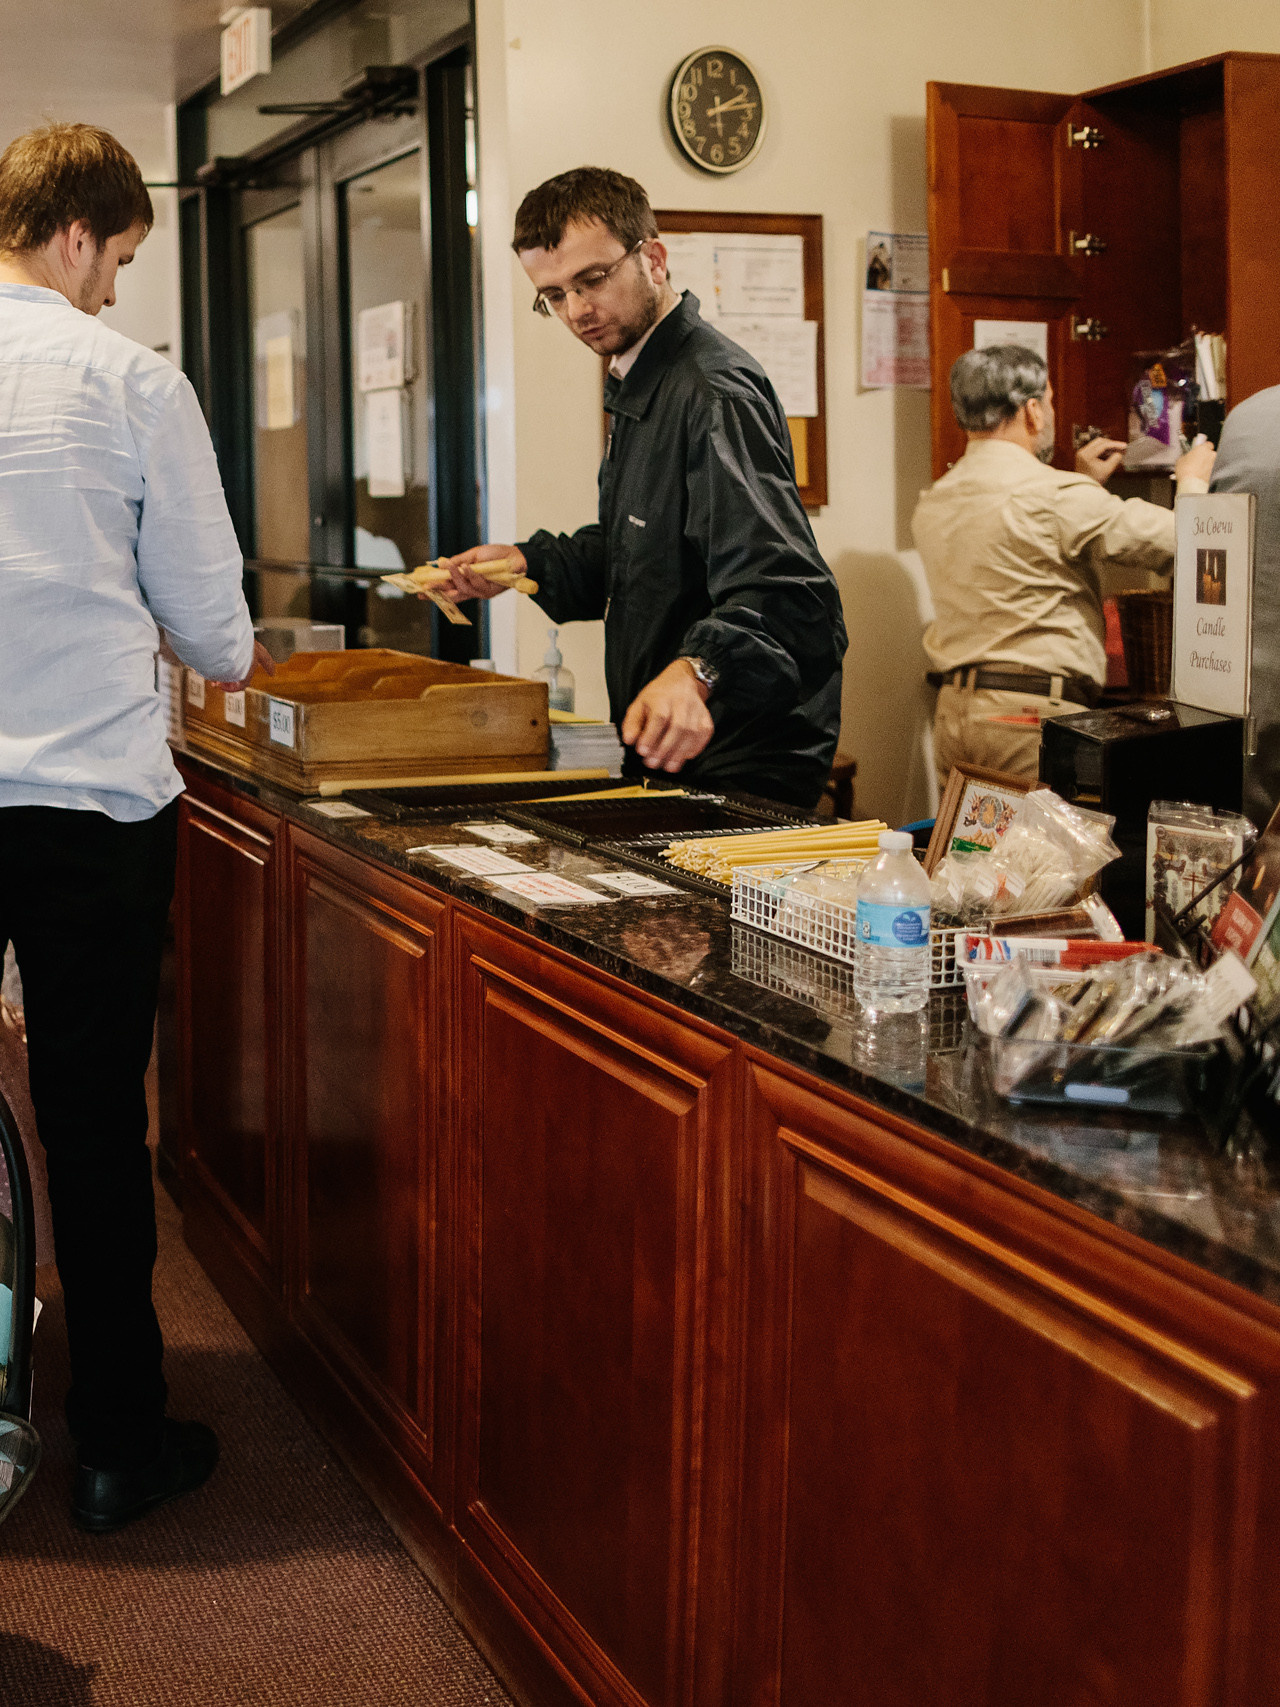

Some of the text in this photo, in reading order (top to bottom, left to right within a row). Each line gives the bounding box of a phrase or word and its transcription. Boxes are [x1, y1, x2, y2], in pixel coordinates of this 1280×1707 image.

[690, 67, 703, 86] 11
[706, 58, 723, 79] 12
[729, 69, 736, 87] 1
[680, 83, 698, 102] 10
[679, 101, 692, 120] 9
[741, 104, 754, 122] 3
[682, 119, 696, 138] 8
[737, 121, 750, 139] 4
[694, 136, 707, 156] 7
[710, 143, 724, 164] 6
[728, 136, 741, 156] 5
[1193, 516, 1233, 536] За Свечи
[1196, 616, 1226, 637] Candle
[1189, 650, 1232, 674] Purchases
